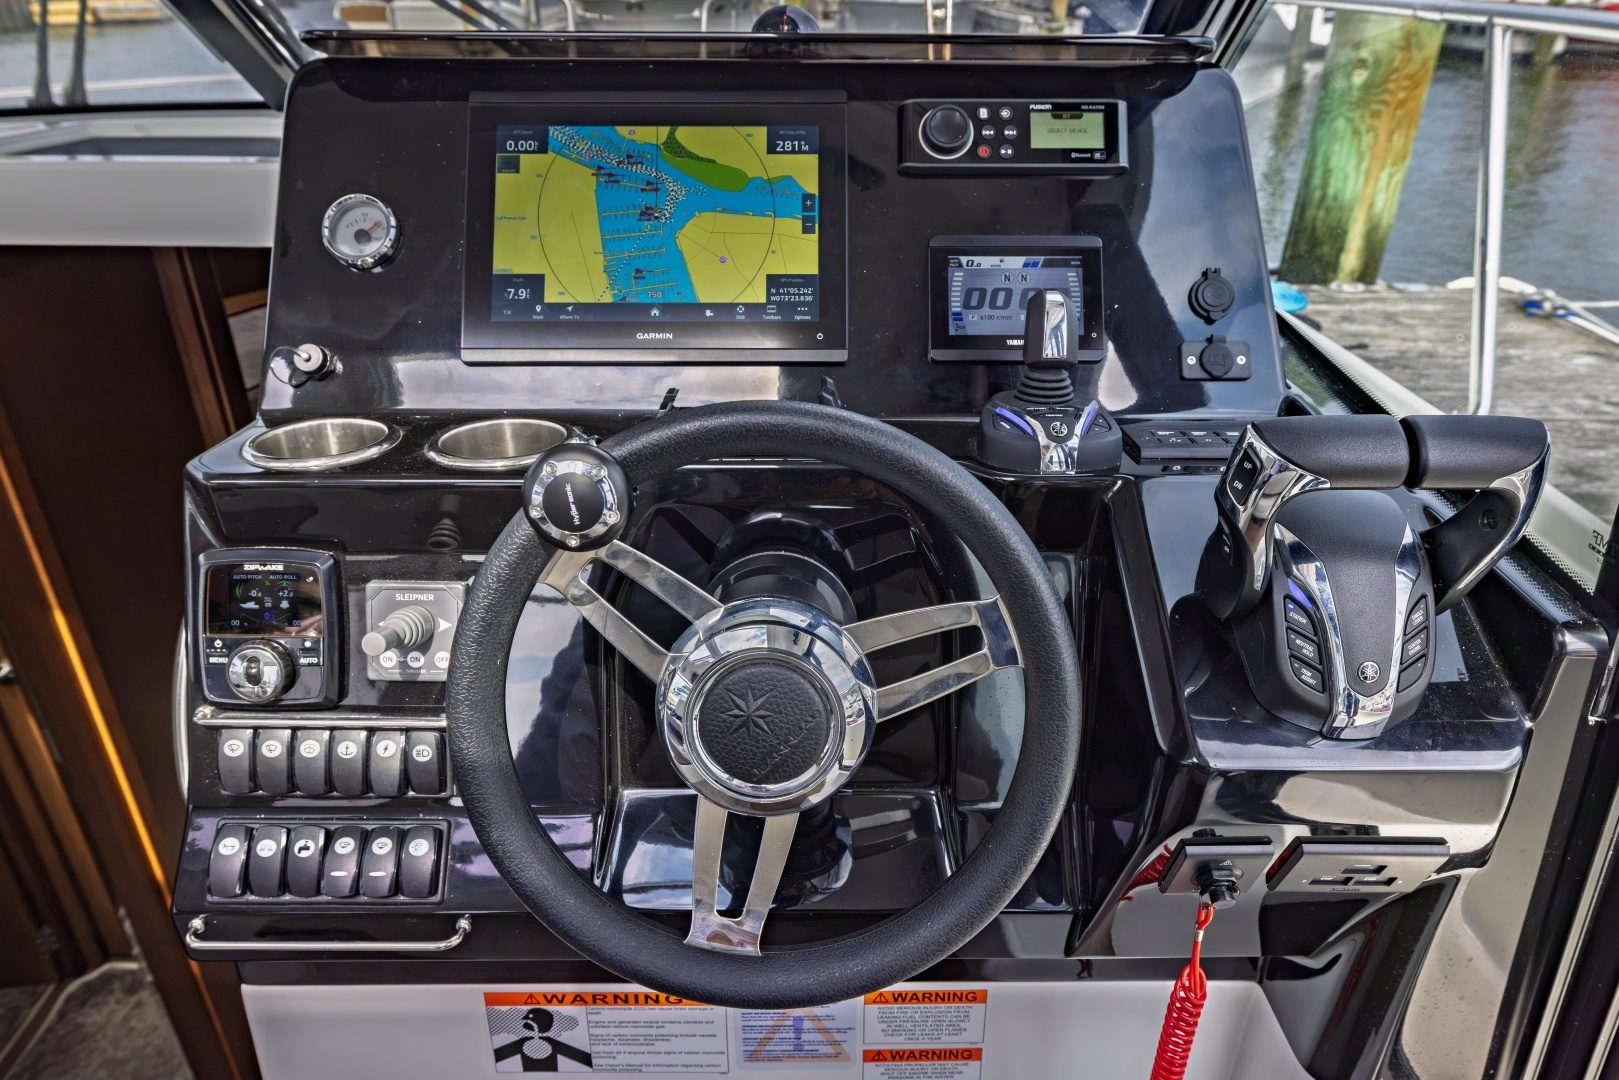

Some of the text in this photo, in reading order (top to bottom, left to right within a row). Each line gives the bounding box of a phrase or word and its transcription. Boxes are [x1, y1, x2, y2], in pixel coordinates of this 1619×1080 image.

[506, 140, 534, 151] 0.00
[1004, 274, 1028, 282] N N
[1244, 461, 1252, 470] UP
[1233, 480, 1243, 490] DN
[396, 593, 434, 601] SLEIPNER
[1289, 612, 1308, 624] STATION
[1296, 638, 1314, 652] NEUTRAL
[1408, 638, 1421, 650] CENTER
[1302, 648, 1314, 658] HOLD
[1301, 668, 1312, 677] TRIM
[1301, 674, 1316, 685] ASSIST
[542, 994, 683, 1004] WARNING
[892, 992, 978, 1002] WARNING
[890, 1049, 974, 1060] WARNING
